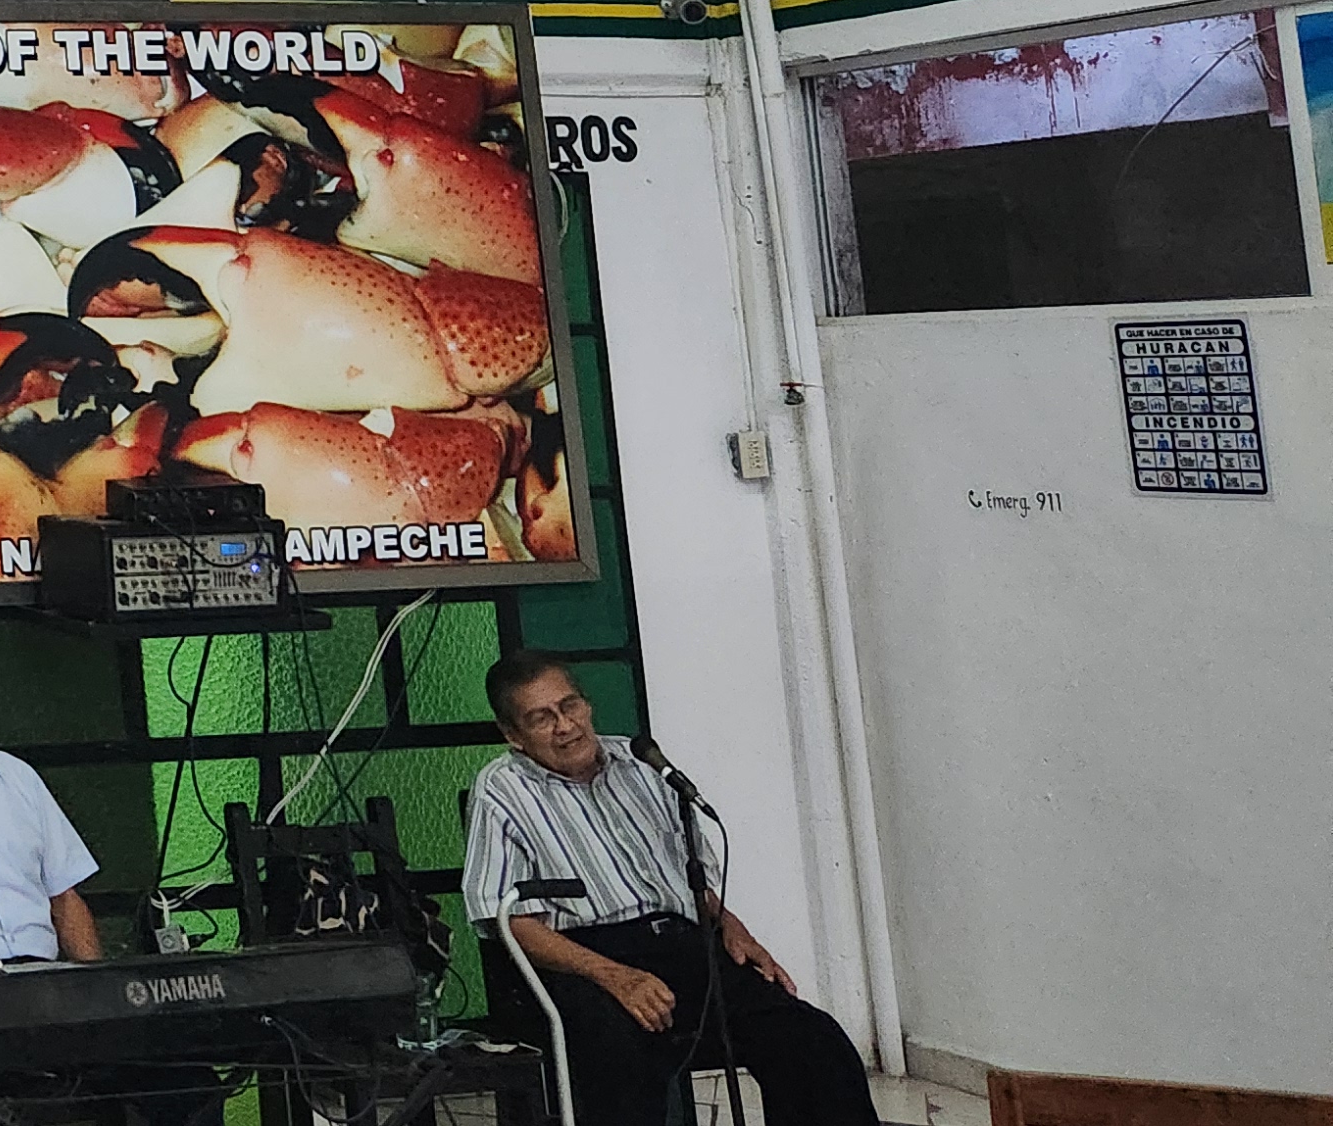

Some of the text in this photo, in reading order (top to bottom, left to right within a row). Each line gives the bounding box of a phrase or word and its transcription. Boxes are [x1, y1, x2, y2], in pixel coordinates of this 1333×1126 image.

[58, 30, 168, 73] THE
[186, 30, 382, 74] WORLD
[1126, 327, 1235, 338] QUE HACER EN CASO DE
[1135, 340, 1230, 354] HURACAN
[1144, 417, 1241, 429] INCENDIO
[986, 490, 1062, 518] Emerg. 911
[285, 524, 486, 562] AMPECHE
[147, 974, 226, 1004] YAMAHA
